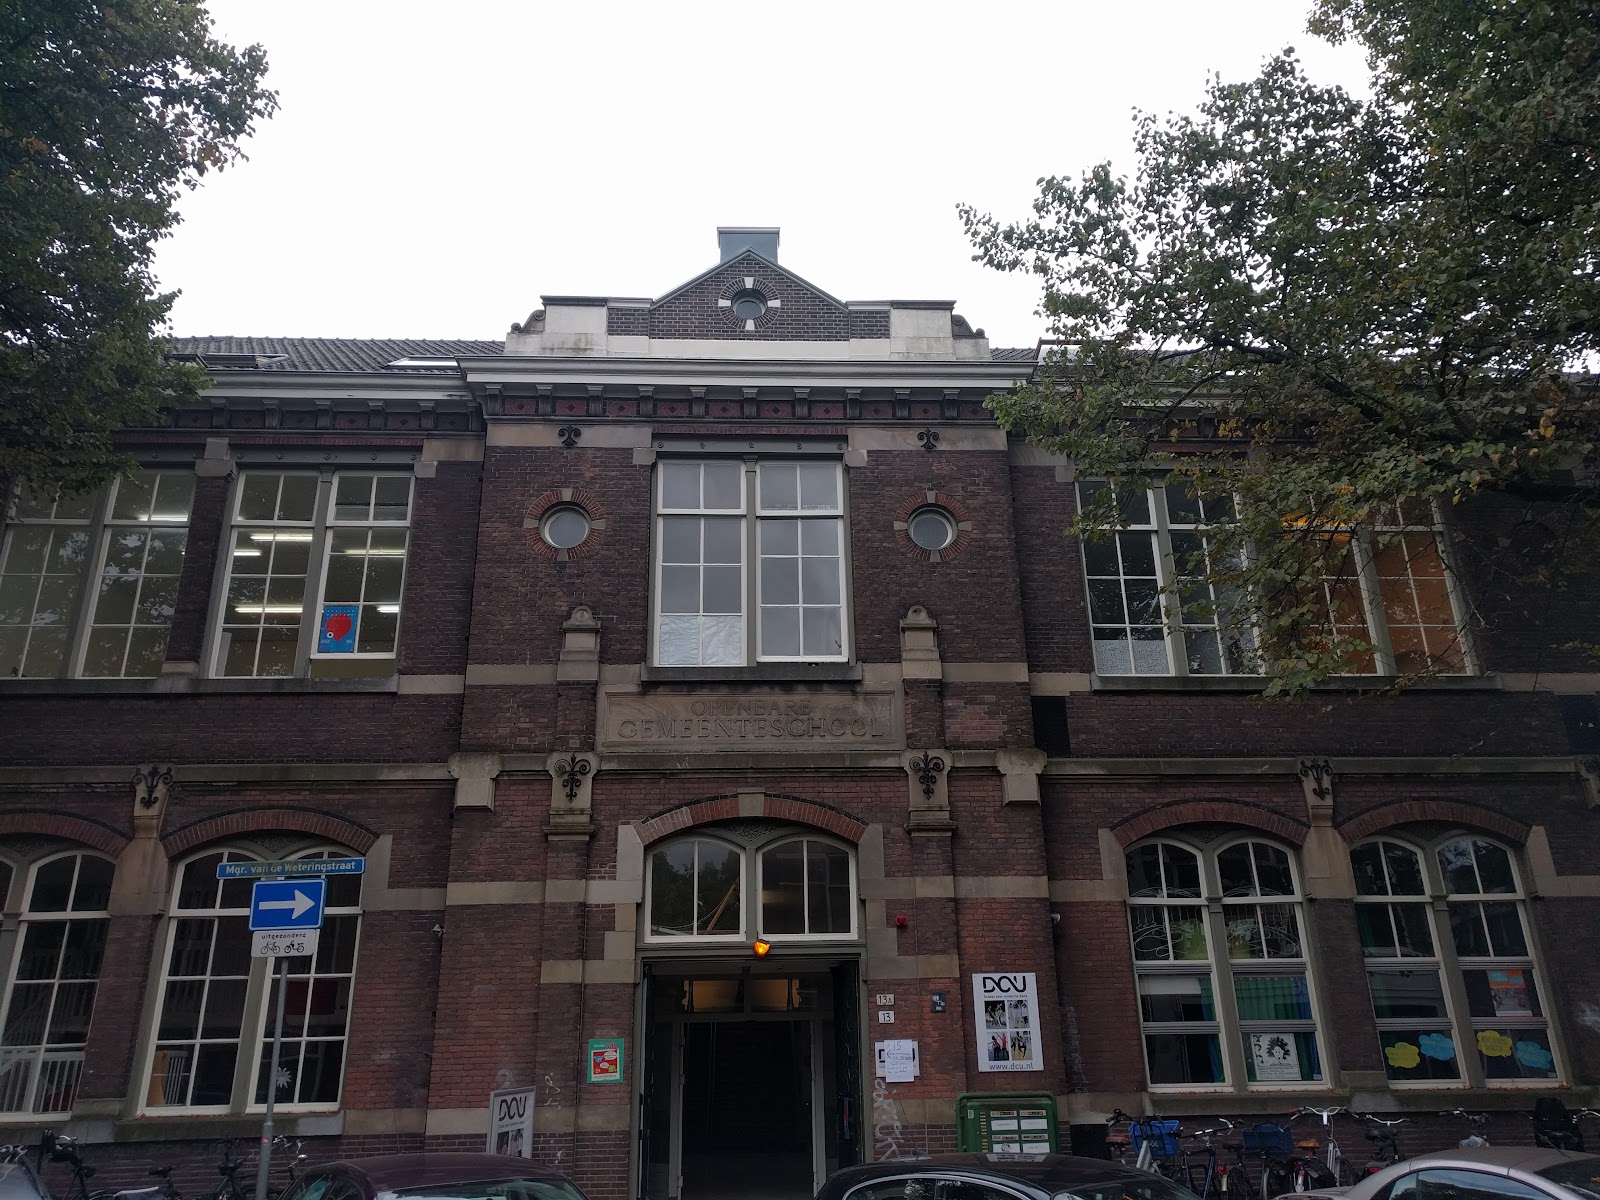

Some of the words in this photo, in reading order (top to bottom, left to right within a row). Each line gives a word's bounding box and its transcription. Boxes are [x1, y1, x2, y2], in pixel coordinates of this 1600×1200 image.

[690, 699, 811, 717] OPENBARE
[617, 718, 885, 739] GEMEENTESCHOOL
[225, 865, 247, 876] Mgr.
[251, 865, 269, 874] van
[270, 863, 283, 873] de
[284, 860, 356, 874] Weteringstraat
[261, 932, 307, 940] uitgezonderd
[982, 975, 1027, 993] DCU
[882, 1012, 892, 1022] 13
[988, 1062, 1034, 1071] www.dcu.nl
